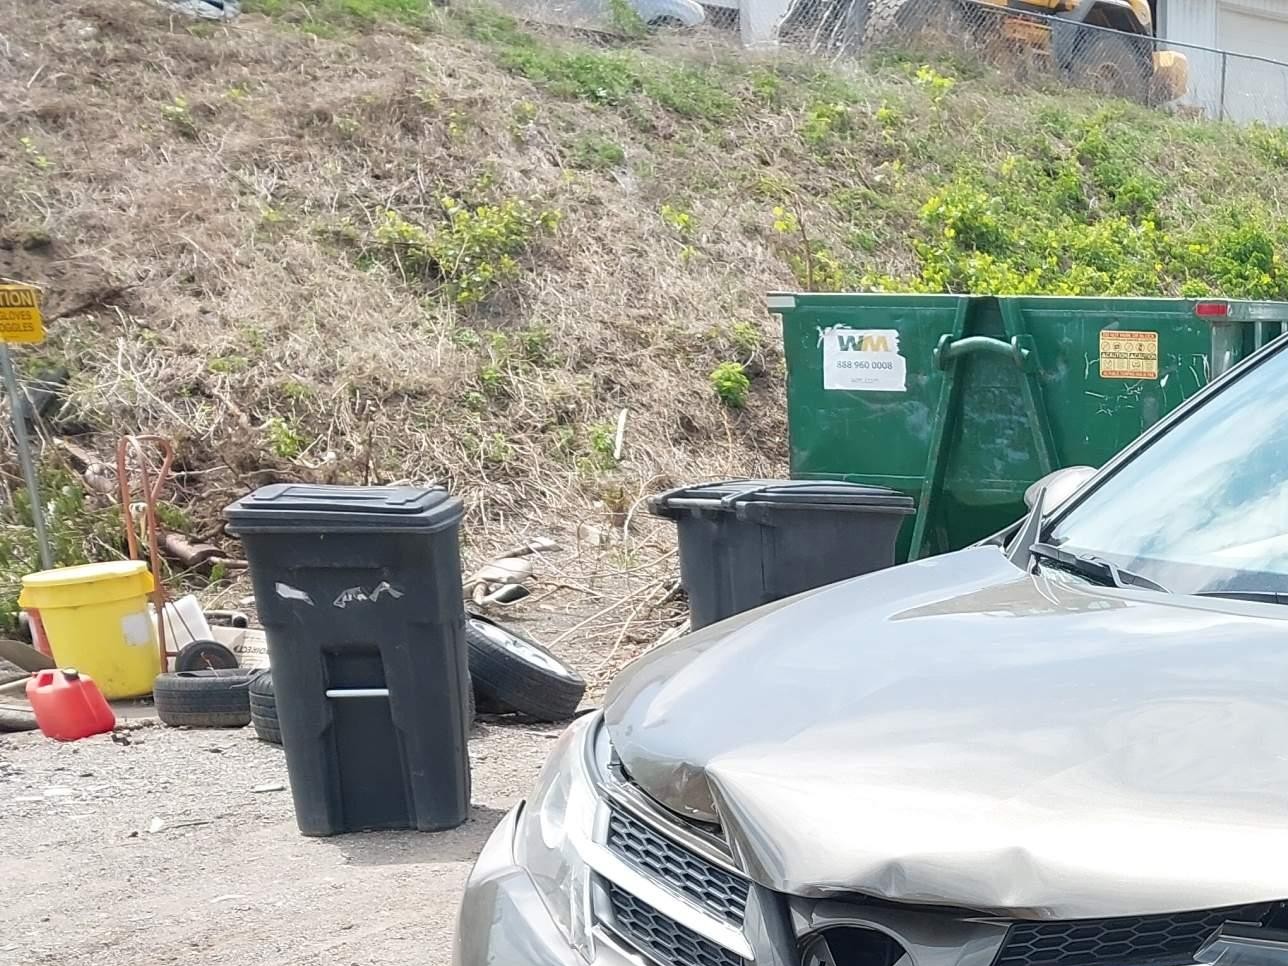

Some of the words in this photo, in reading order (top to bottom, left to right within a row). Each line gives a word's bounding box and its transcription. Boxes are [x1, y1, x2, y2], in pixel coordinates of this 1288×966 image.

[837, 335, 890, 352] WM
[836, 360, 853, 369] 888
[853, 360, 870, 369] 960
[871, 361, 893, 370] 0008
